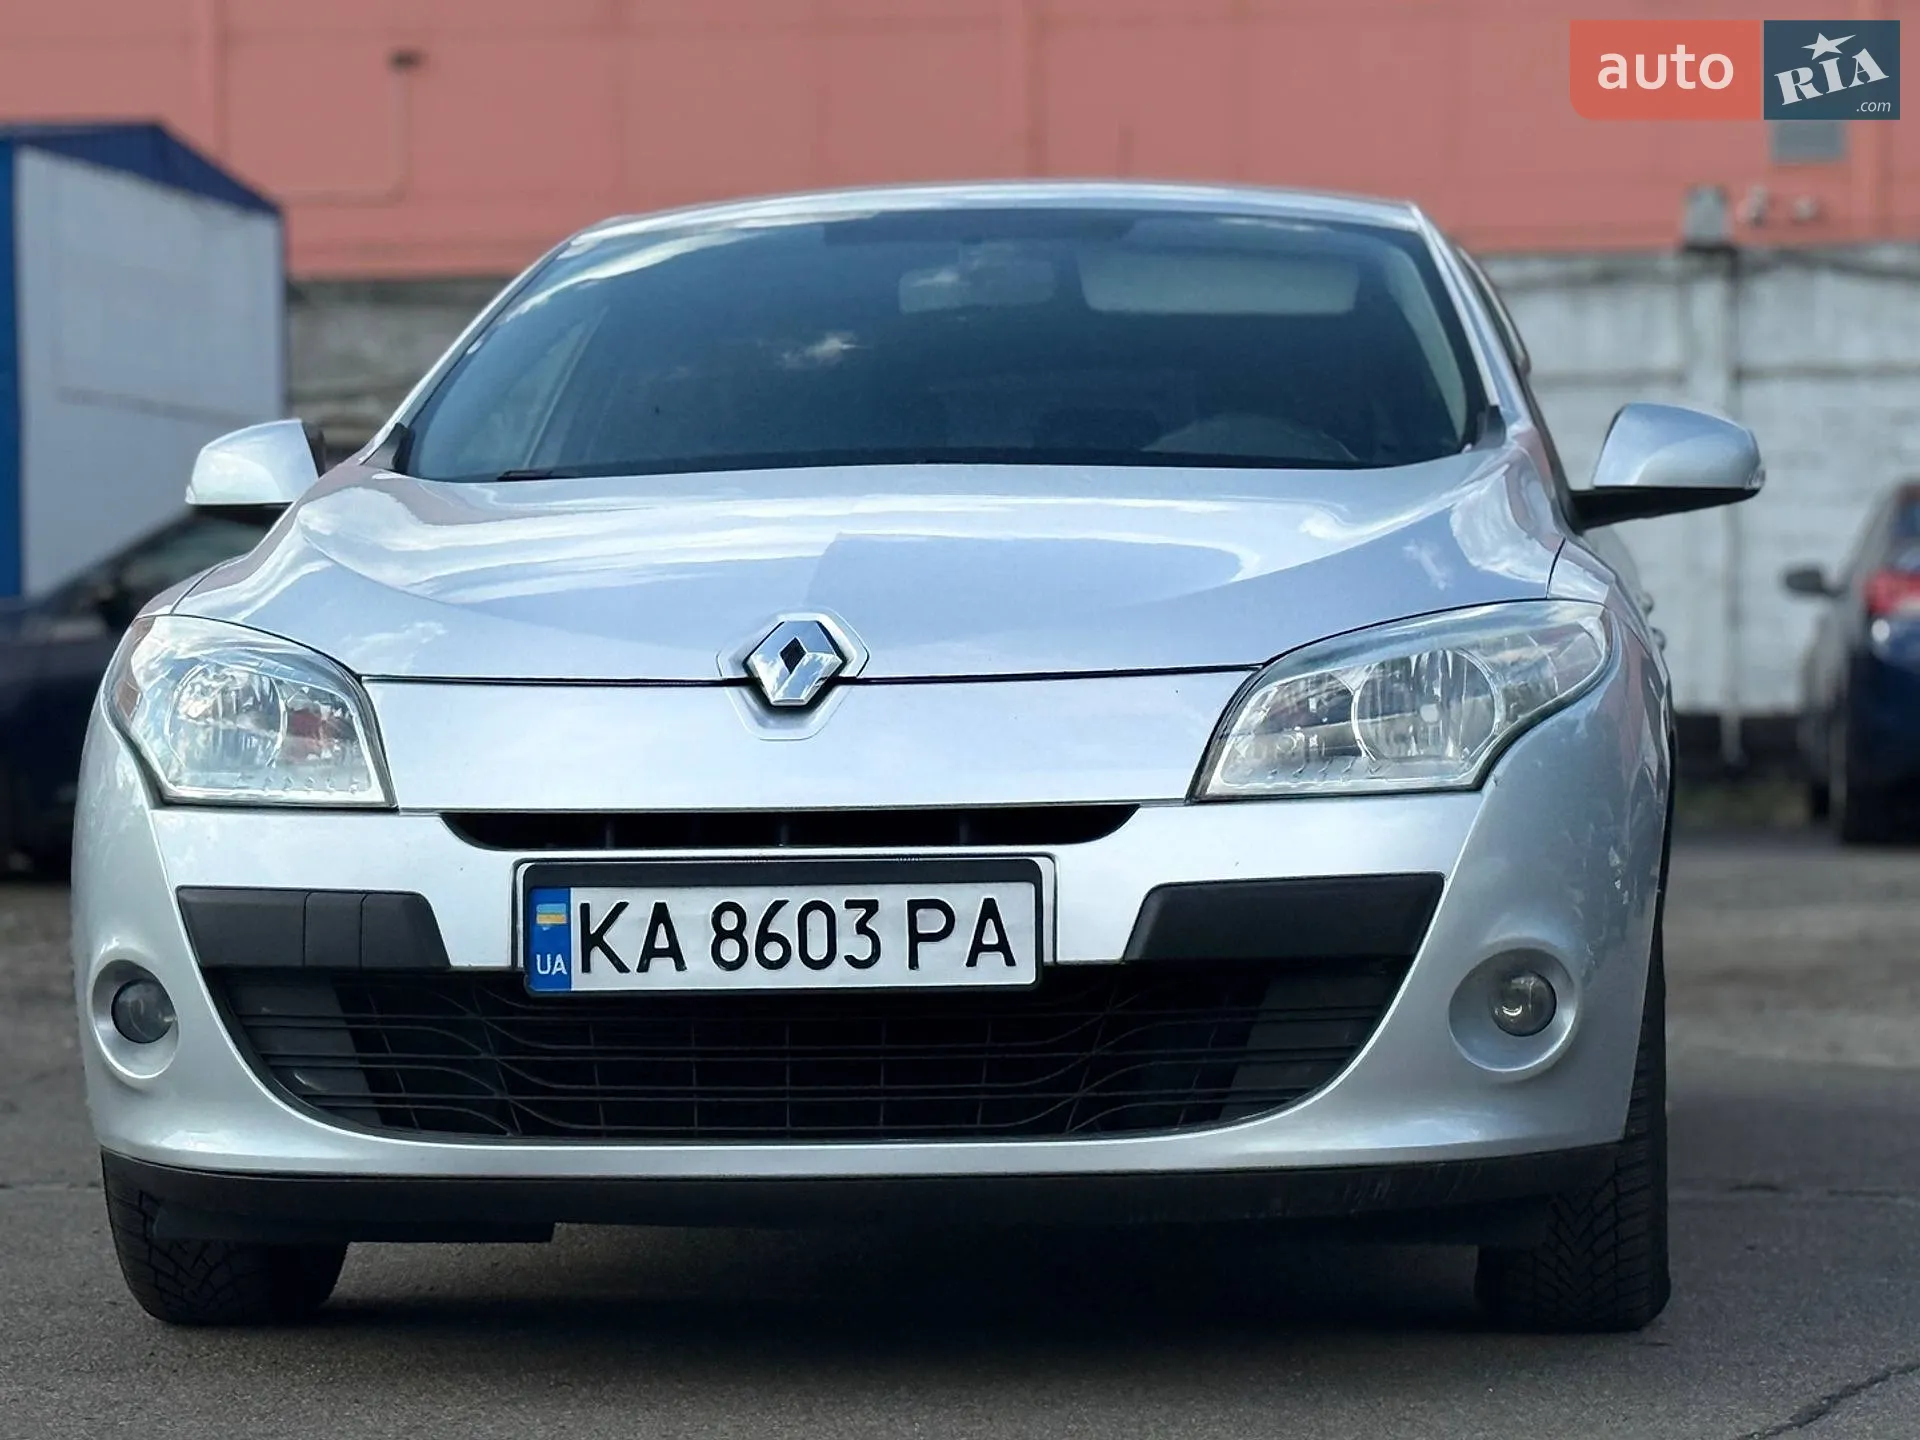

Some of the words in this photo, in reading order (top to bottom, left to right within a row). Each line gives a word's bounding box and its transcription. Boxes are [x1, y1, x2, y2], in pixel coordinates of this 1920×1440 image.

[579, 900, 688, 974] KA
[710, 899, 882, 971] 8603
[907, 896, 1017, 971] PA
[536, 955, 568, 977] UA
